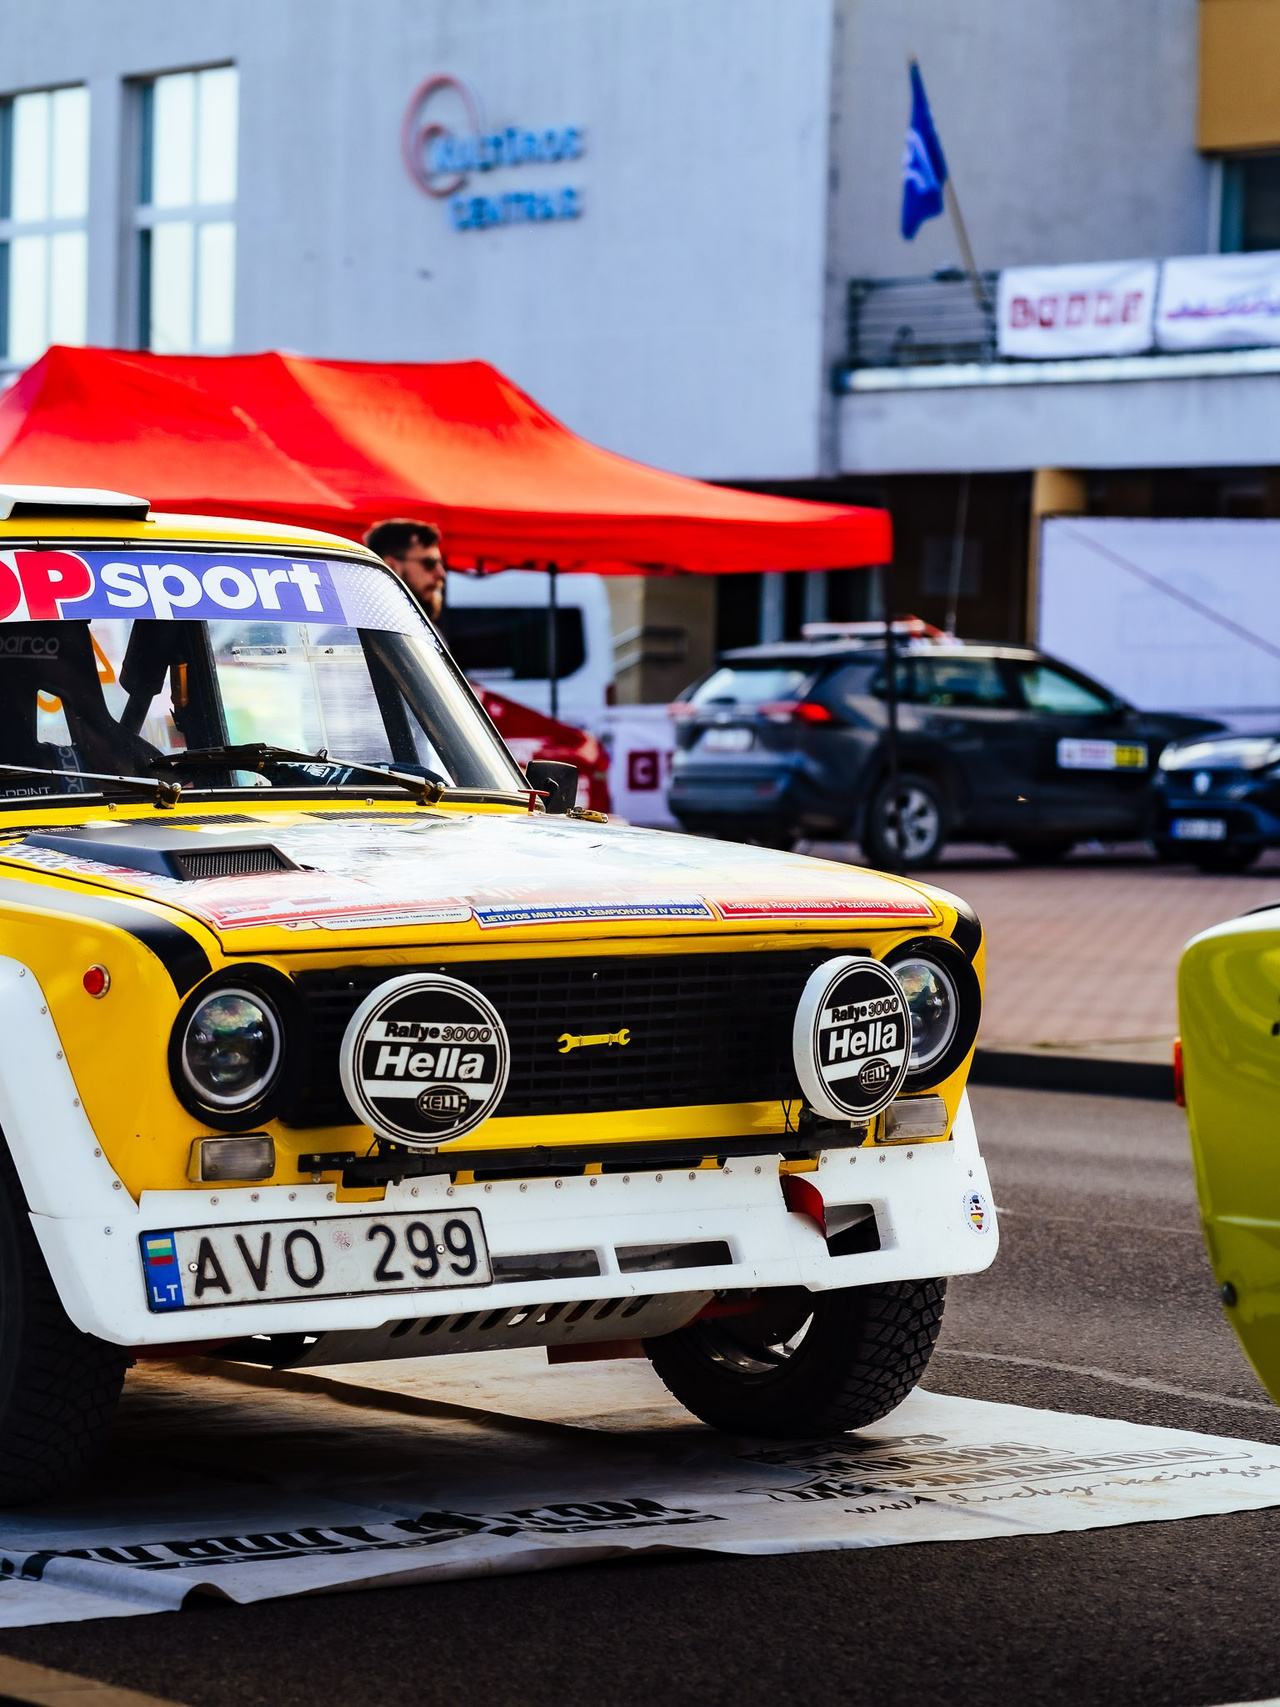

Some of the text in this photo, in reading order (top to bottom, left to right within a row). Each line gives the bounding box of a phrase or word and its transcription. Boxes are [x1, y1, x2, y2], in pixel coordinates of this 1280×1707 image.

[480, 912, 531, 923] LIETUVOS
[531, 911, 555, 919] MINI
[555, 909, 587, 918] RALIO
[670, 907, 708, 915] ETAPAS
[724, 900, 771, 909] Lietuvos
[770, 900, 833, 911] Respublikos
[833, 900, 889, 909] Prezidento
[831, 997, 899, 1024] Rallye 3000
[384, 1021, 492, 1042] Rallye 3000
[828, 1021, 898, 1062] Hella
[374, 1045, 486, 1080] Hella
[860, 1063, 892, 1084] HELLA
[420, 1095, 468, 1114] HELLA
[192, 1219, 478, 1298] AVO 299
[153, 1284, 178, 1303] LT
